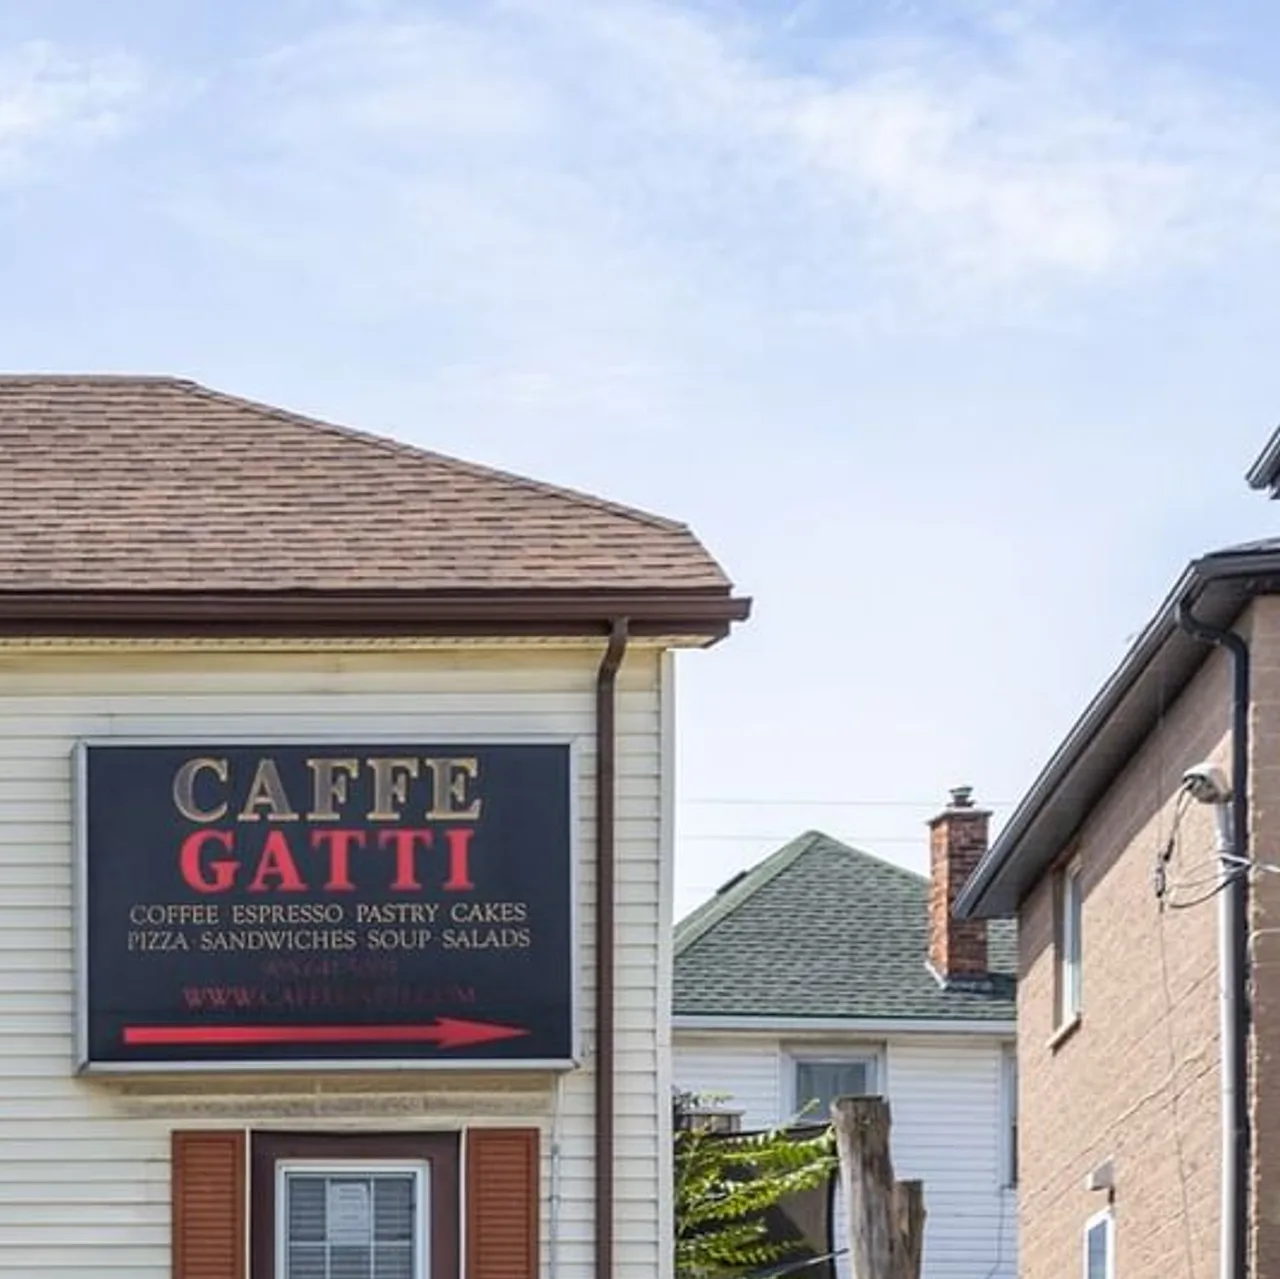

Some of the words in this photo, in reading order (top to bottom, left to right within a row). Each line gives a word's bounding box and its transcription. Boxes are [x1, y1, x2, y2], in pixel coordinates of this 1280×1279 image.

[173, 757, 481, 822] CAFFE
[180, 828, 475, 893] GATTI
[130, 904, 219, 925] COFFEE
[233, 903, 343, 925] ESPRESSO
[356, 902, 439, 924] PASTRY
[451, 902, 527, 924] CAKES
[127, 930, 189, 951] PIZZA
[201, 929, 357, 951] SANDWICHES
[368, 928, 432, 950] SOUP
[442, 928, 531, 949] SALADS
